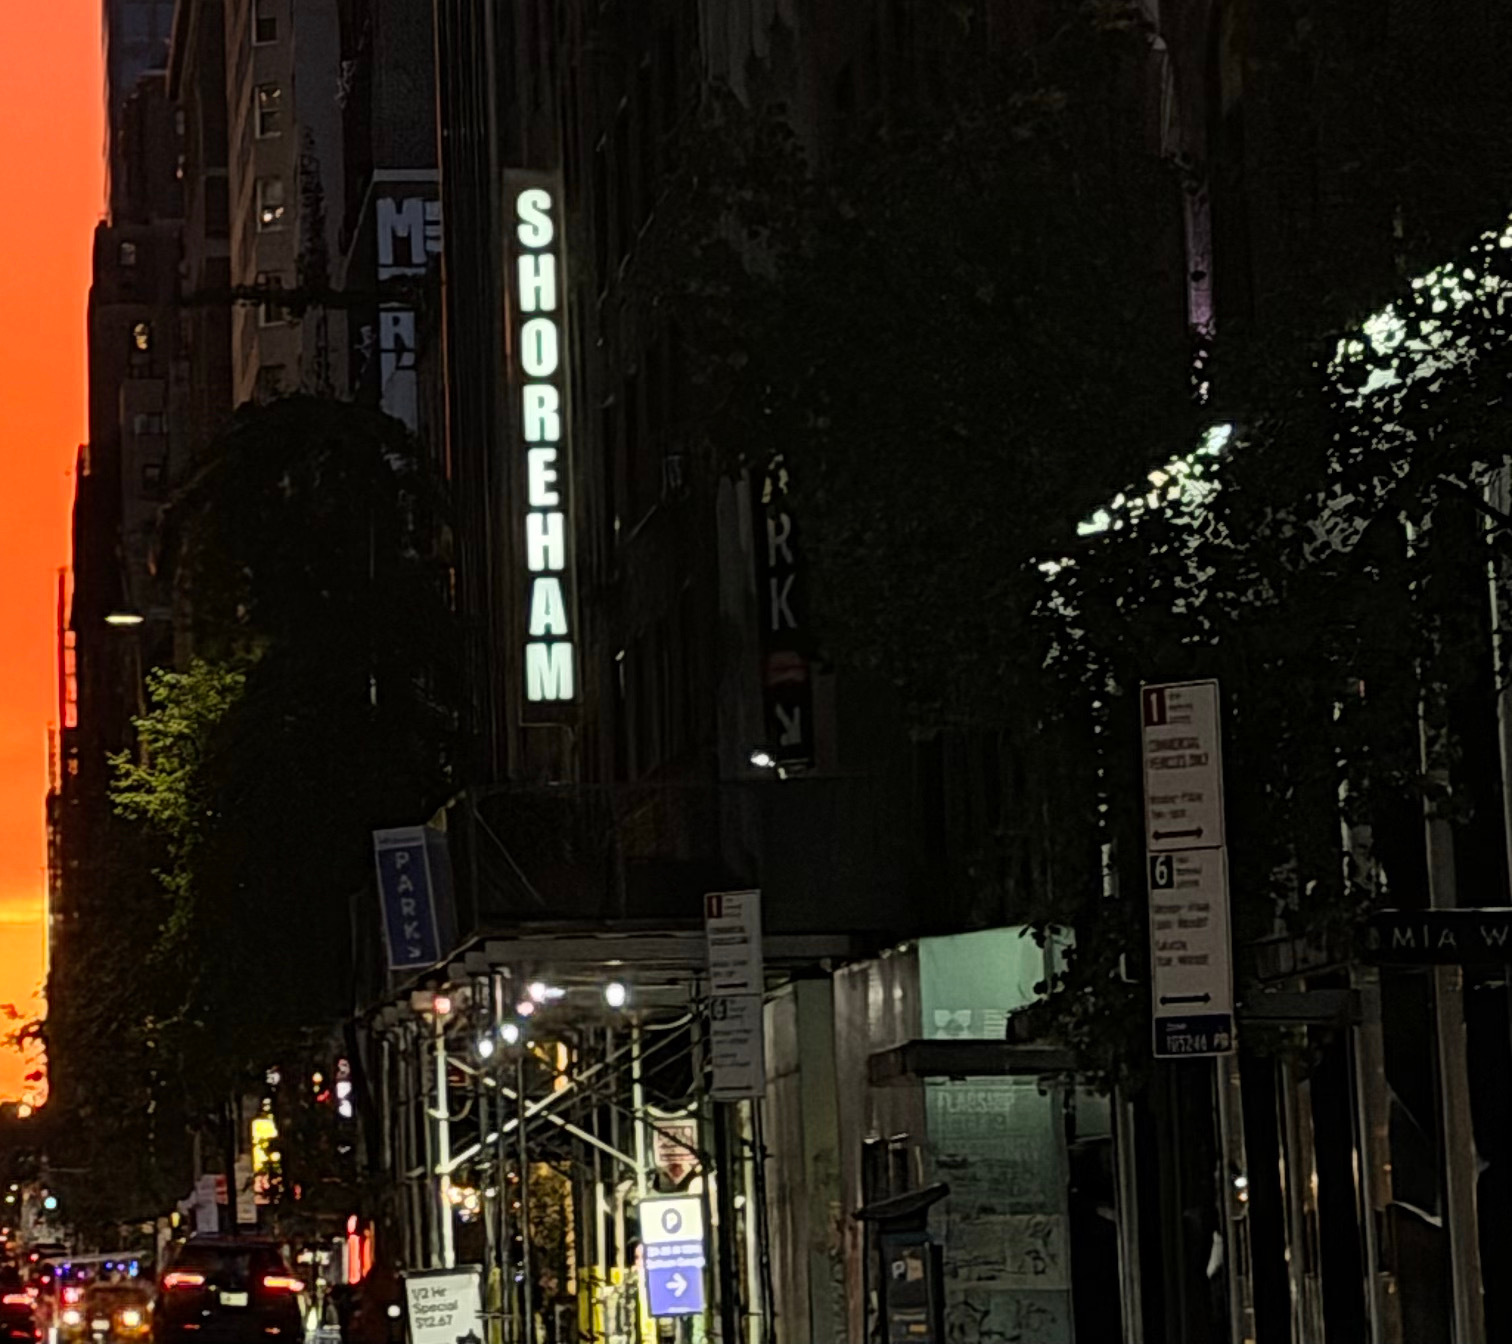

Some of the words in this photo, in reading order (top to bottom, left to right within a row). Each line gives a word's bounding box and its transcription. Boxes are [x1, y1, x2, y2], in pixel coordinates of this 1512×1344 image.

[517, 188, 574, 701] SHOREHAM
[1149, 691, 1159, 724] 1
[394, 850, 422, 940] PARK
[1154, 856, 1168, 886] 6
